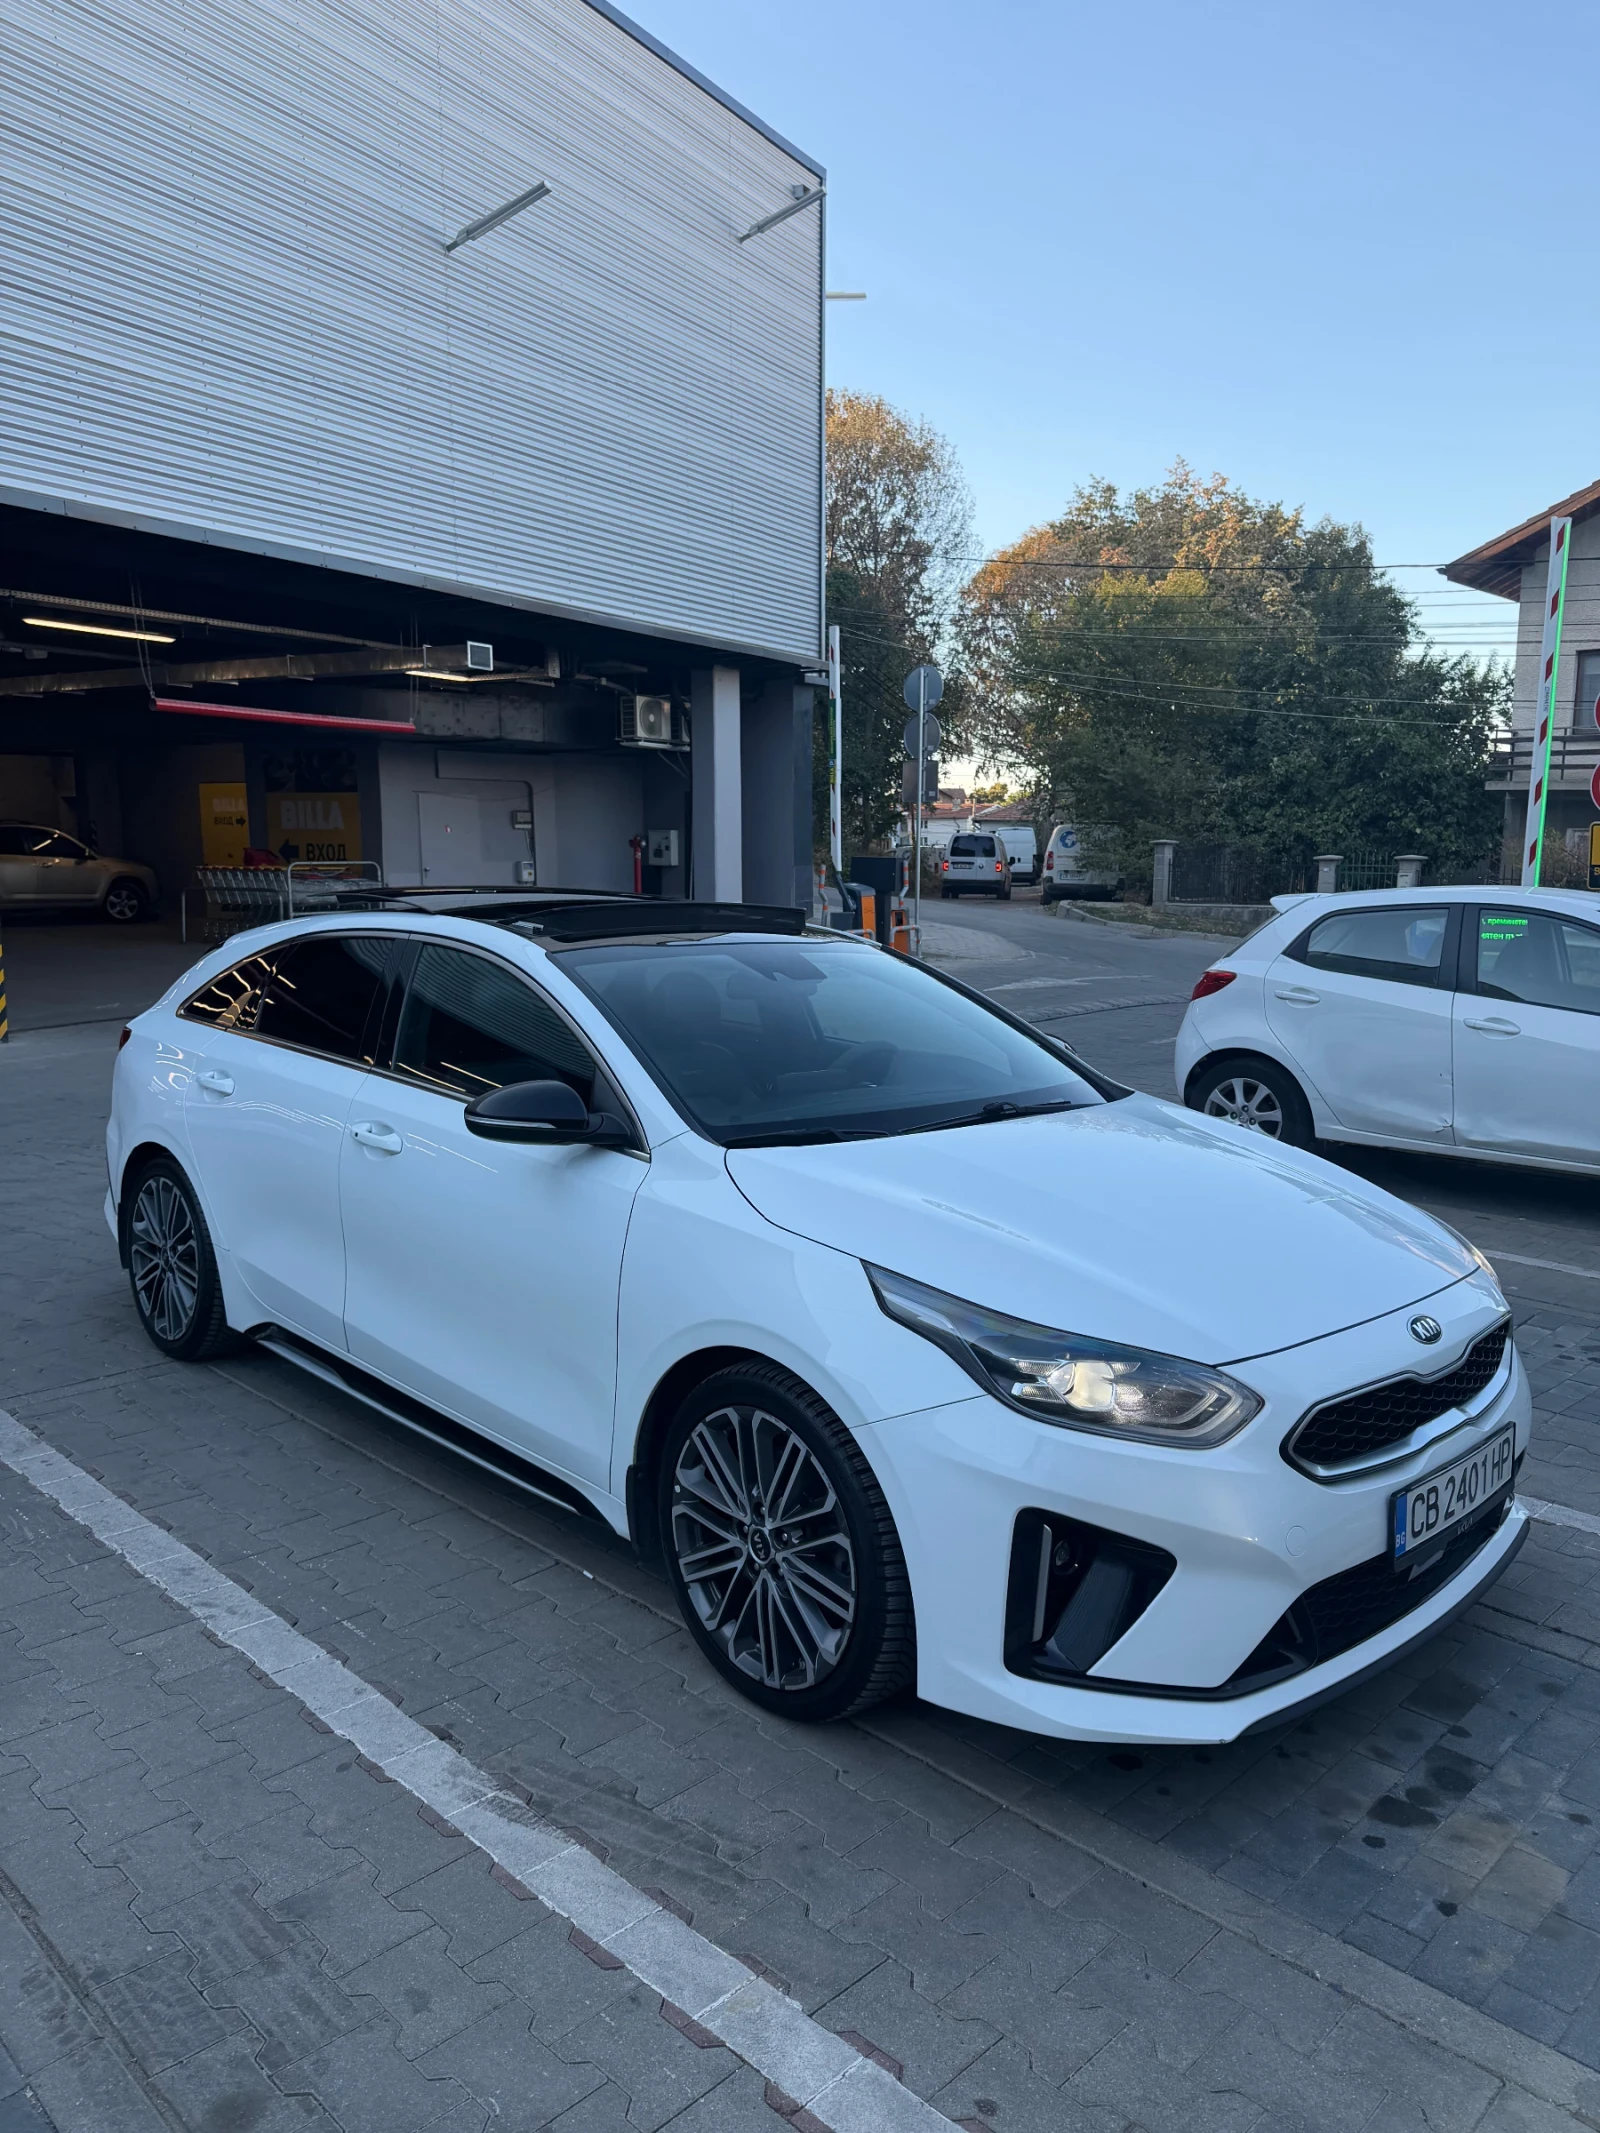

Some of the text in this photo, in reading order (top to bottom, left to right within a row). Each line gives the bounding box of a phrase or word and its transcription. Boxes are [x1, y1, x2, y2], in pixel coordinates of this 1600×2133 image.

[212, 798, 245, 812] BILLA
[214, 816, 234, 826] ВХОД
[279, 800, 345, 830] BILLA
[306, 843, 347, 862] ВХОД
[1412, 1318, 1440, 1340] KIA
[1443, 1452, 1488, 1522] 2401
[1395, 1531, 1406, 1548] BG
